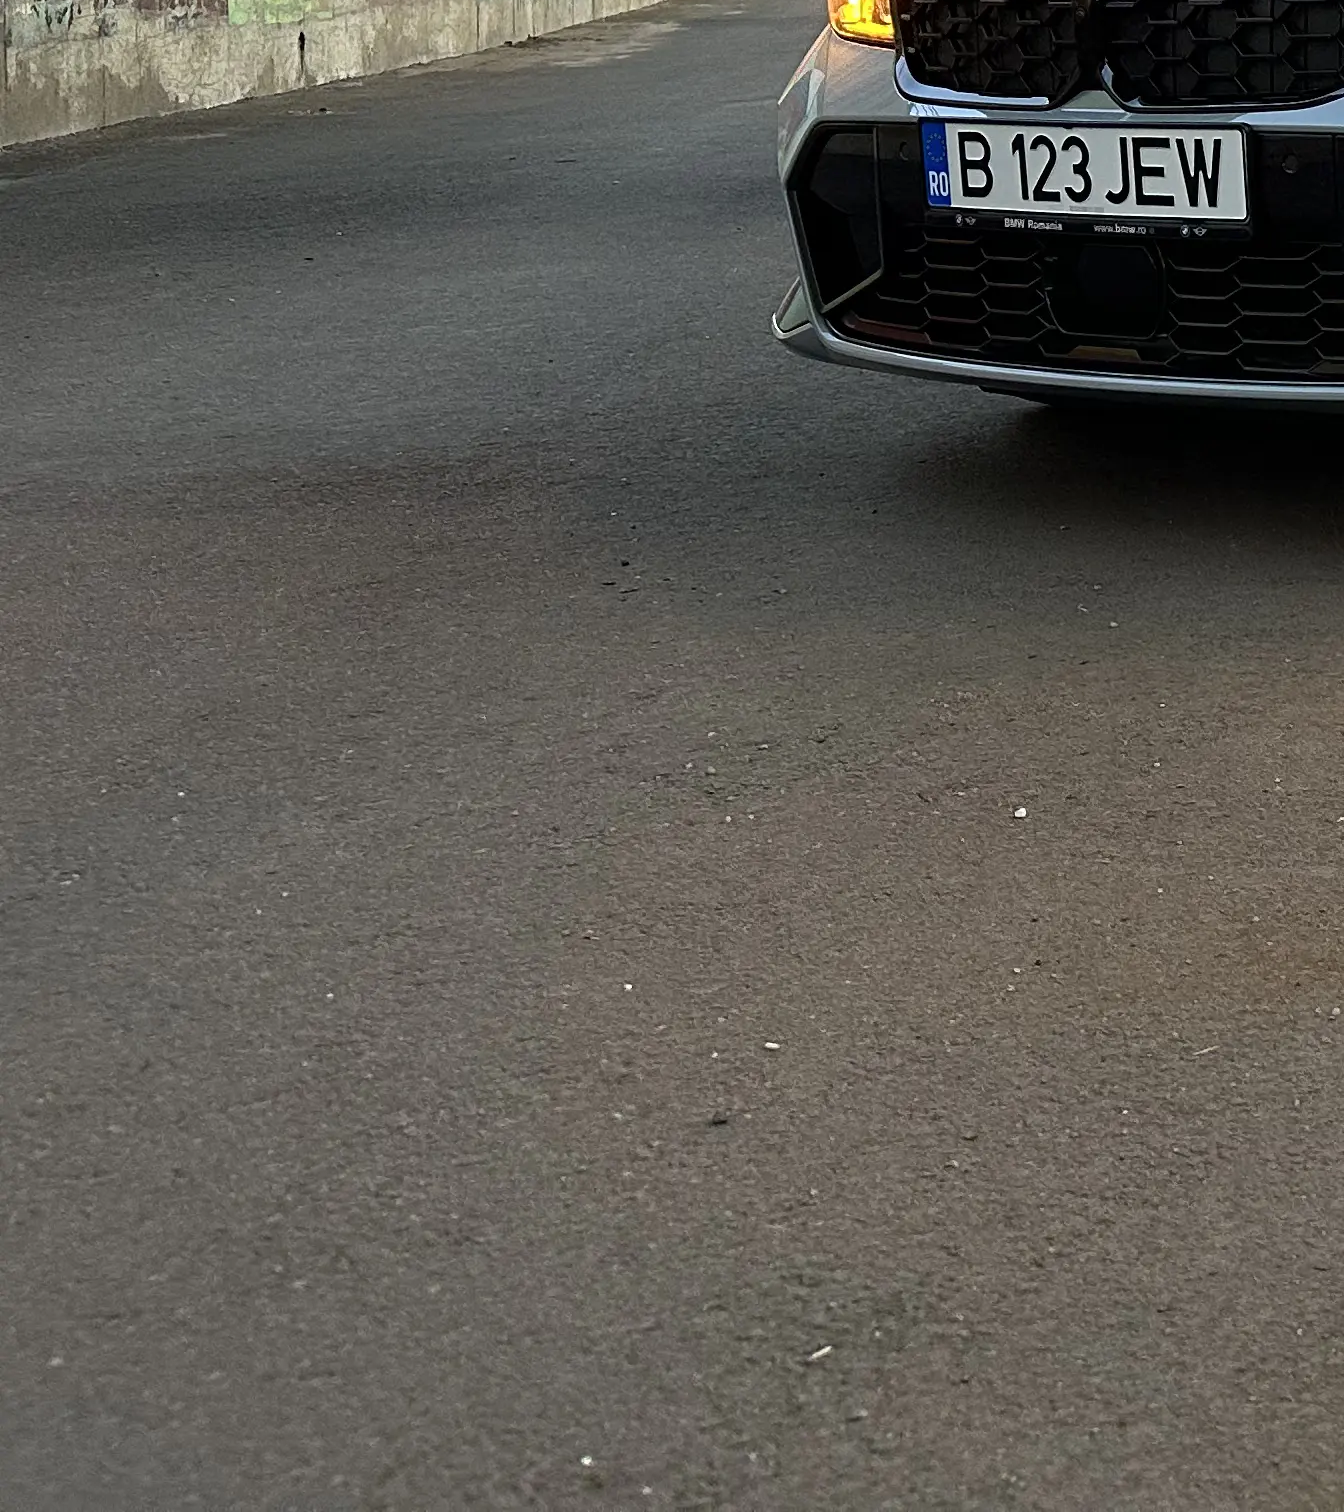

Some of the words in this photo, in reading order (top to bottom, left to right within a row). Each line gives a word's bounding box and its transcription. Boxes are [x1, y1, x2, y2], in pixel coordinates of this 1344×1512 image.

[957, 131, 994, 198] B
[1011, 133, 1092, 203] 123
[1105, 136, 1222, 208] JEW
[928, 170, 948, 197] RO
[1003, 217, 1025, 229] BMW
